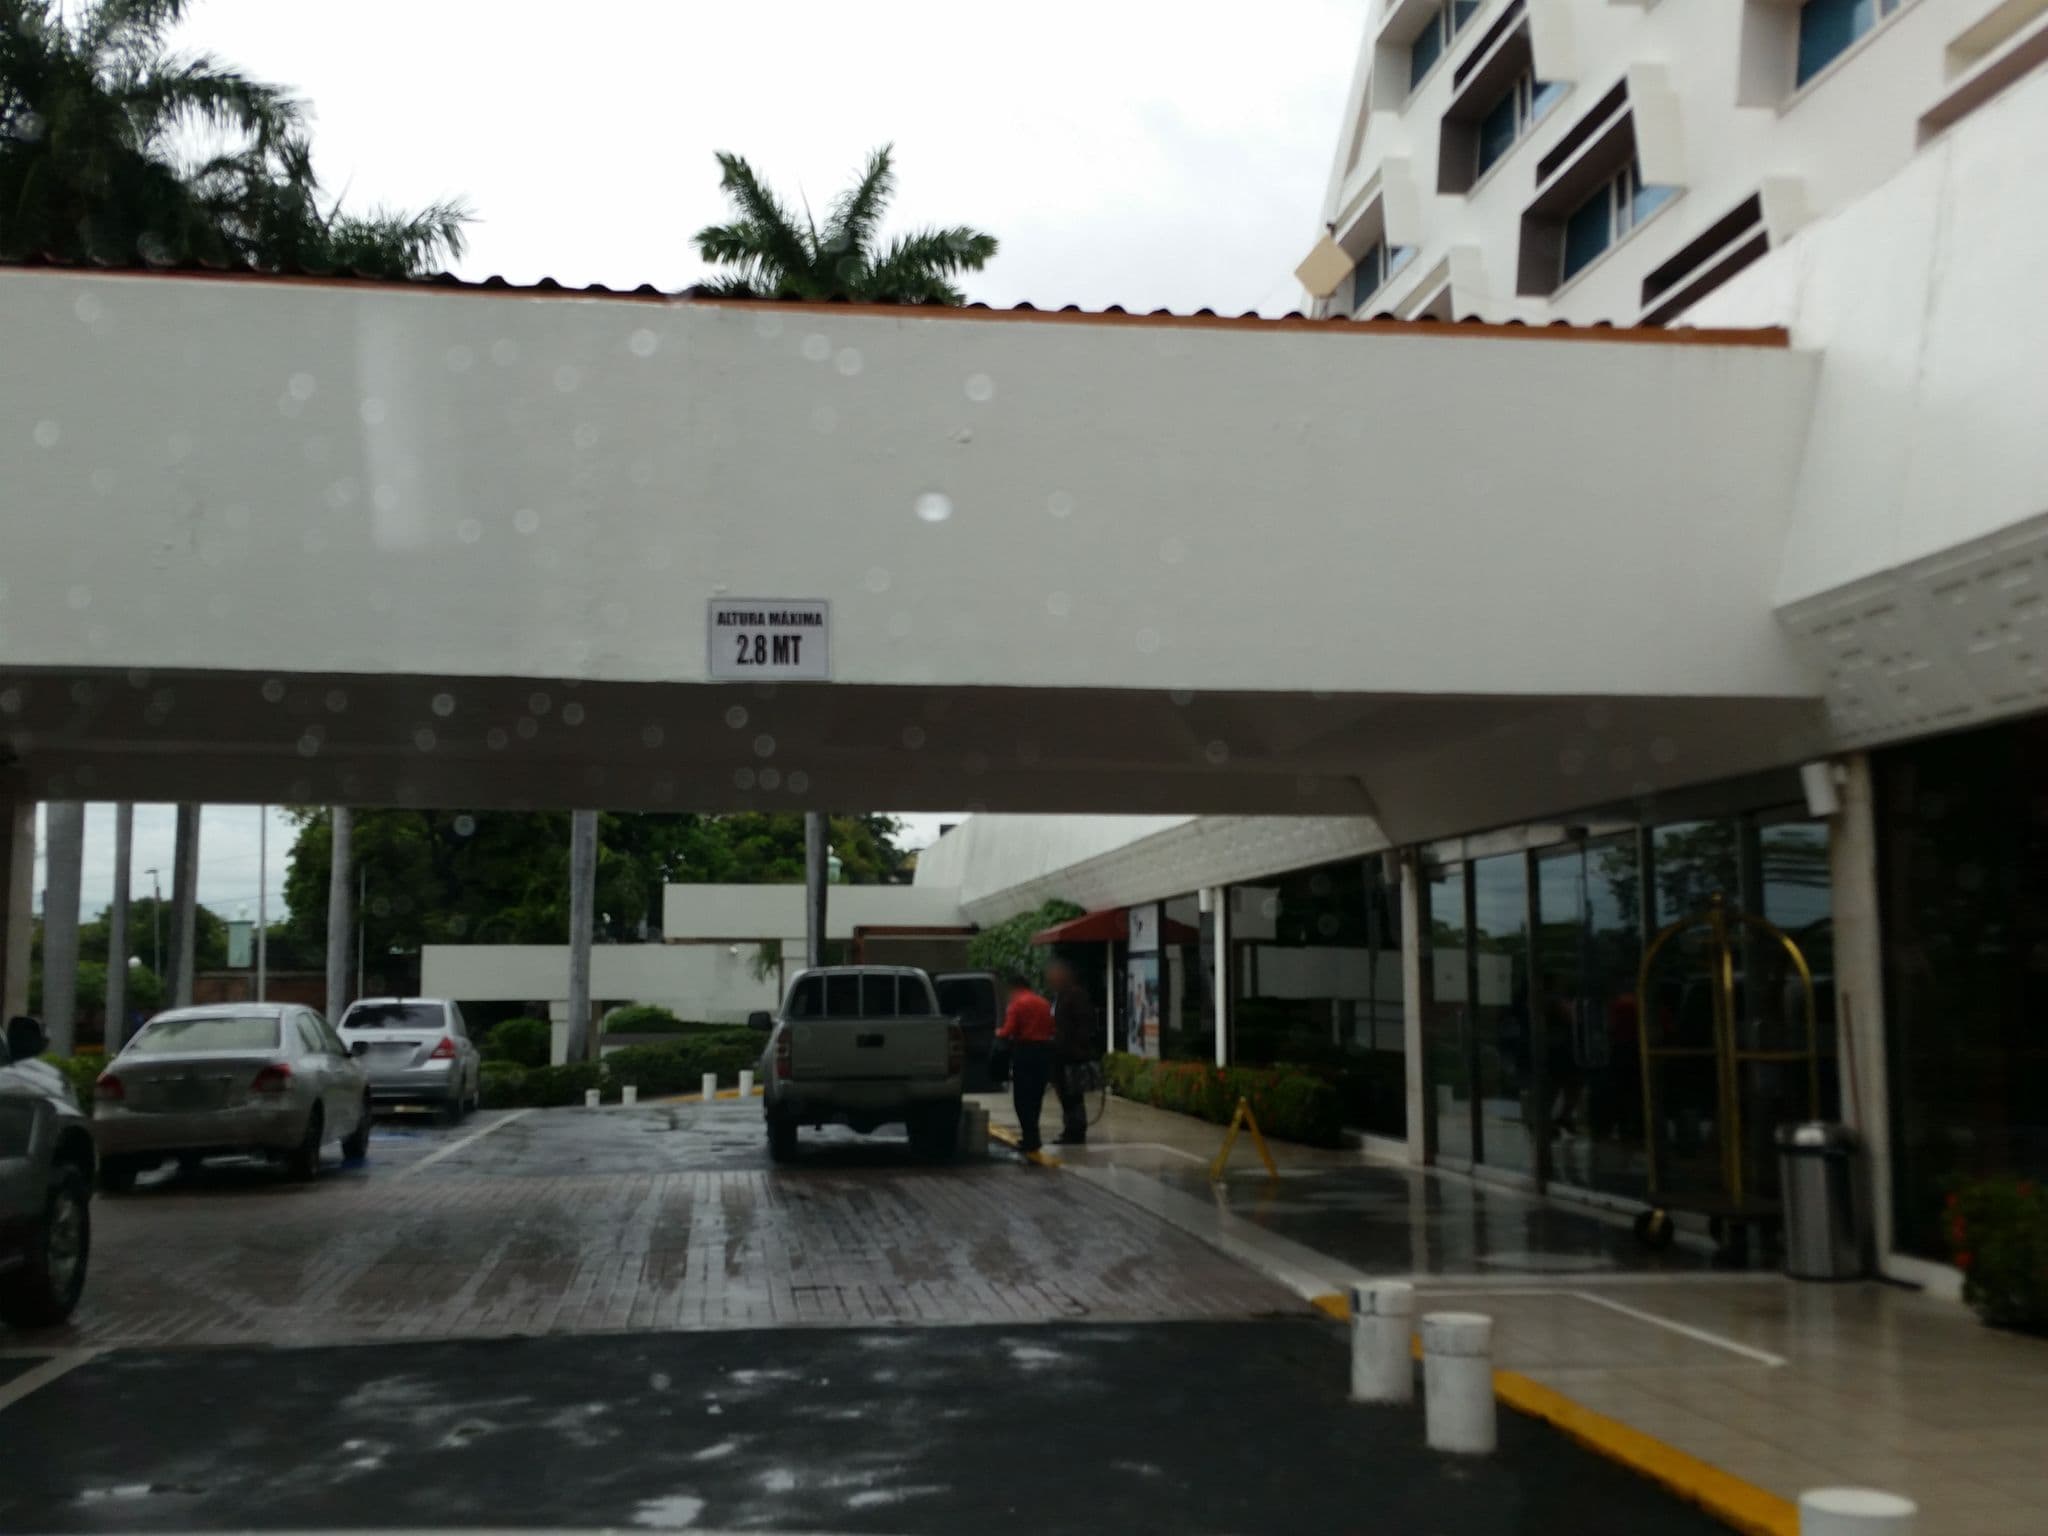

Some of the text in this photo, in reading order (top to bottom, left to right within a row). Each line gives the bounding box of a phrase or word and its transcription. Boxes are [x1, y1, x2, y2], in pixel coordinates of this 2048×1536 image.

[717, 610, 823, 627] ALTURA MÁXIMA
[736, 634, 802, 665] 2.8 MT
